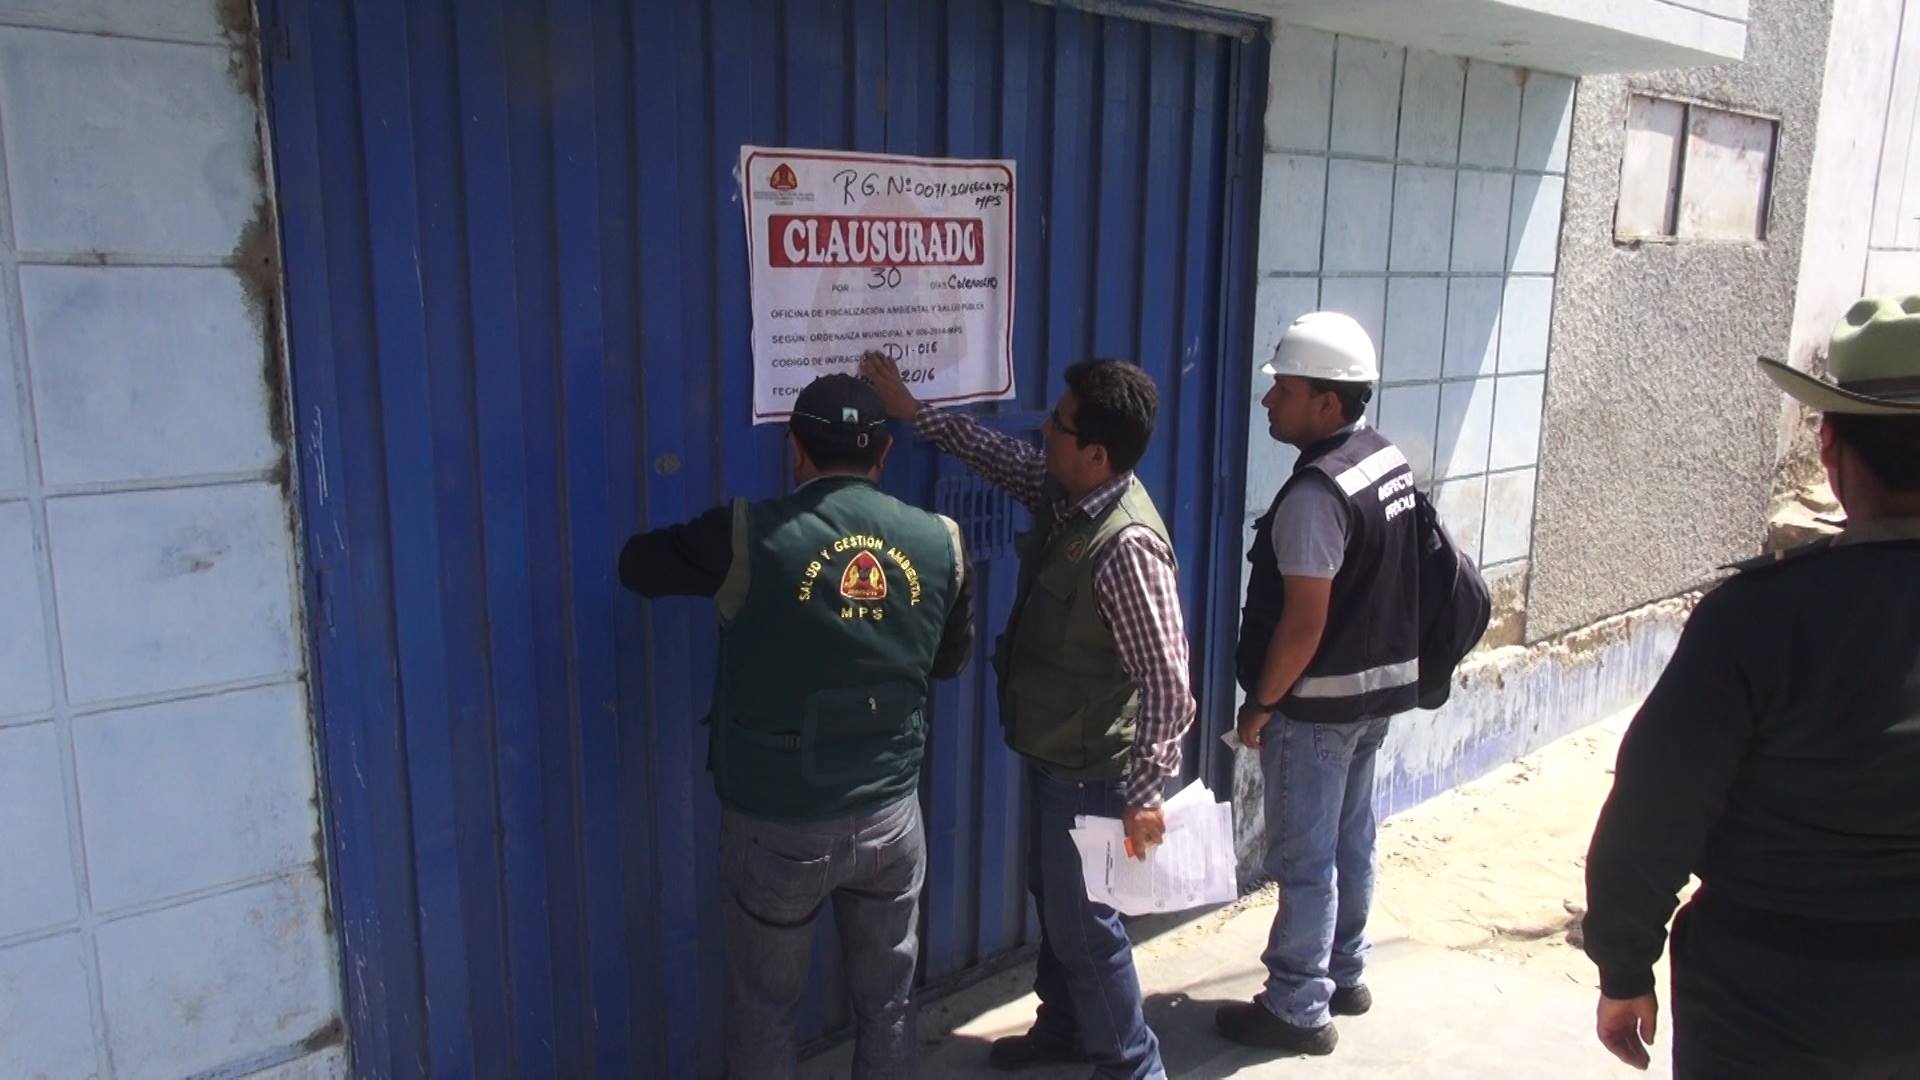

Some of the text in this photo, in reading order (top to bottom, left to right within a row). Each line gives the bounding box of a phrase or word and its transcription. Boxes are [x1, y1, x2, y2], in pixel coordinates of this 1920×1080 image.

[783, 218, 976, 263] CLAUSURADO
[867, 267, 902, 289] 30
[770, 309, 809, 318] OFICINA
[811, 309, 823, 317] DE
[886, 305, 929, 314] AMBIENTAL
[810, 331, 860, 342] ORDENANZA
[862, 330, 903, 339] MUNICIPAL
[812, 357, 823, 366] DE
[900, 368, 936, 383] 2016
[798, 561, 822, 601] SALUD
[820, 549, 831, 560] Y
